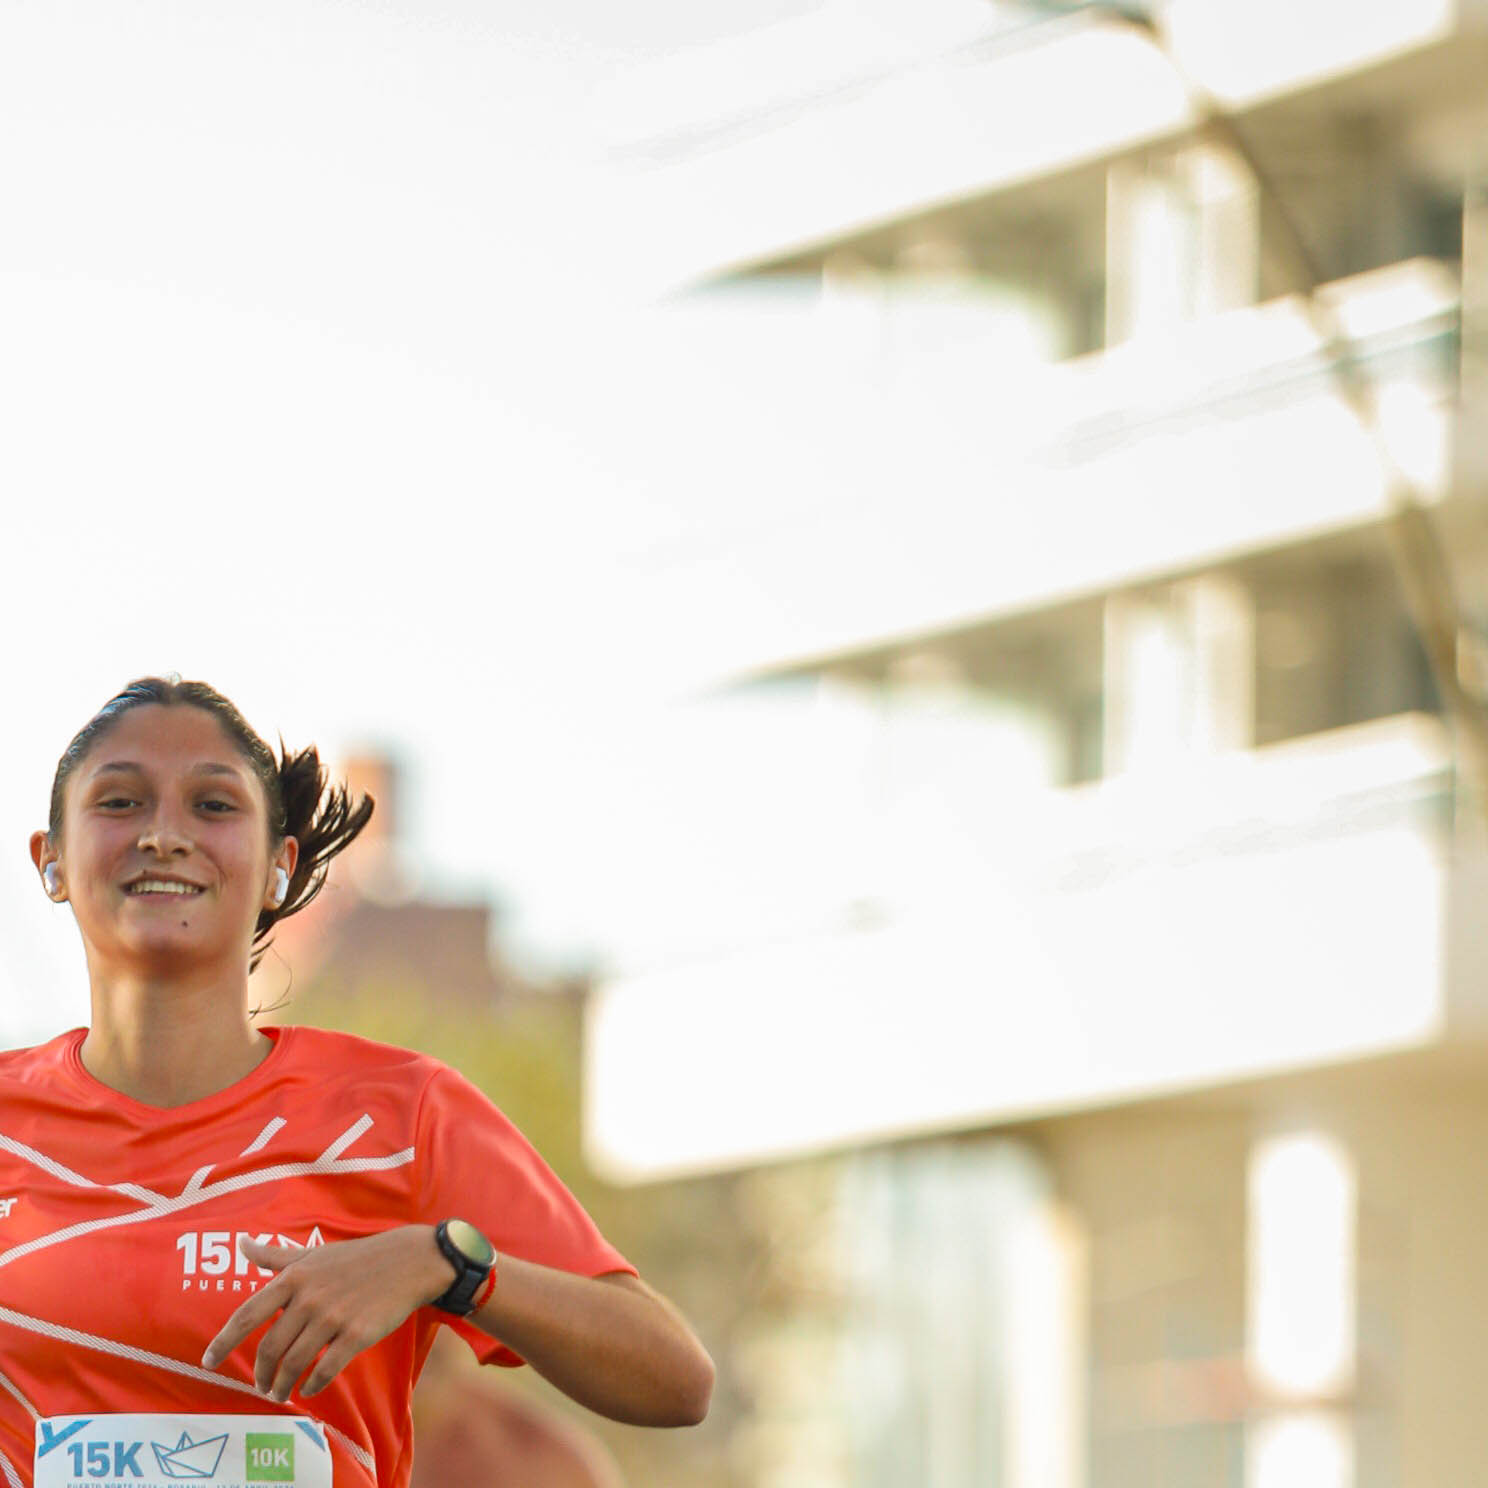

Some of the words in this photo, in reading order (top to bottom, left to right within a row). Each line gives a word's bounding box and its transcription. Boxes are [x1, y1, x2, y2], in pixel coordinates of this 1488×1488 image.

[176, 1231, 274, 1277] 15K
[182, 1279, 270, 1292] PUERT
[67, 1440, 145, 1478] 15K
[250, 1447, 290, 1469] 10K
